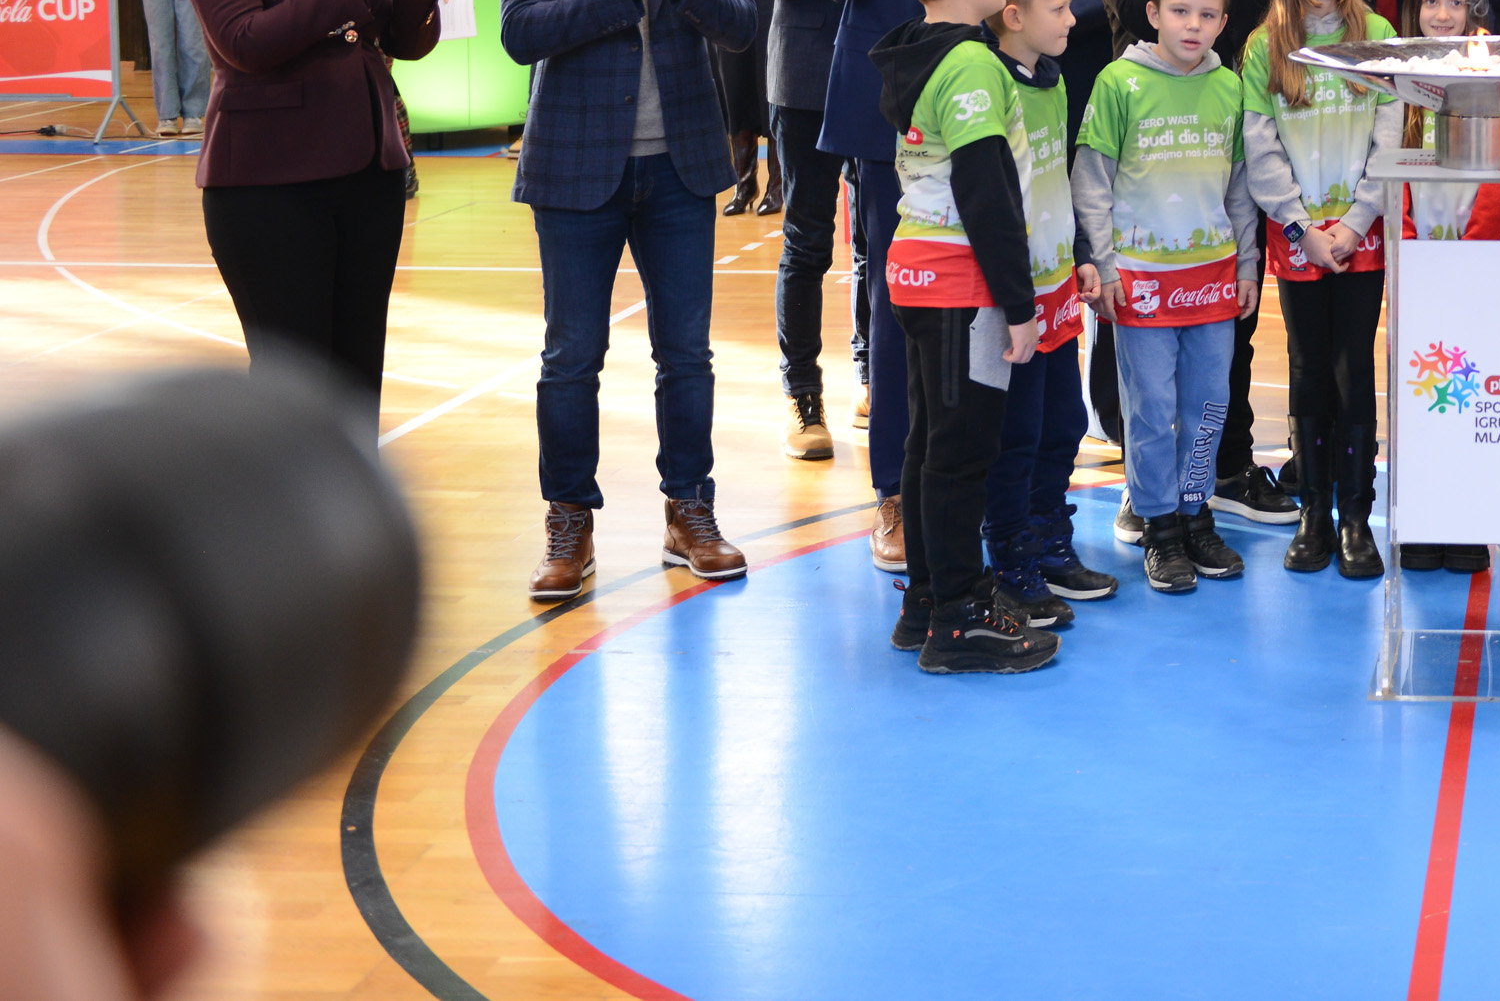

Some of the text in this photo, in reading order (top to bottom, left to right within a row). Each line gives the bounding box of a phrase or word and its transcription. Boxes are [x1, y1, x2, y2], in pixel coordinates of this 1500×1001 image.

[1314, 85, 1336, 103] dio
[1138, 114, 1199, 130] ZERO WASTE
[1138, 129, 1175, 149] budi
[1178, 128, 1200, 145] dio
[899, 268, 936, 287] CUP
[1167, 281, 1222, 309] Coca-Cola
